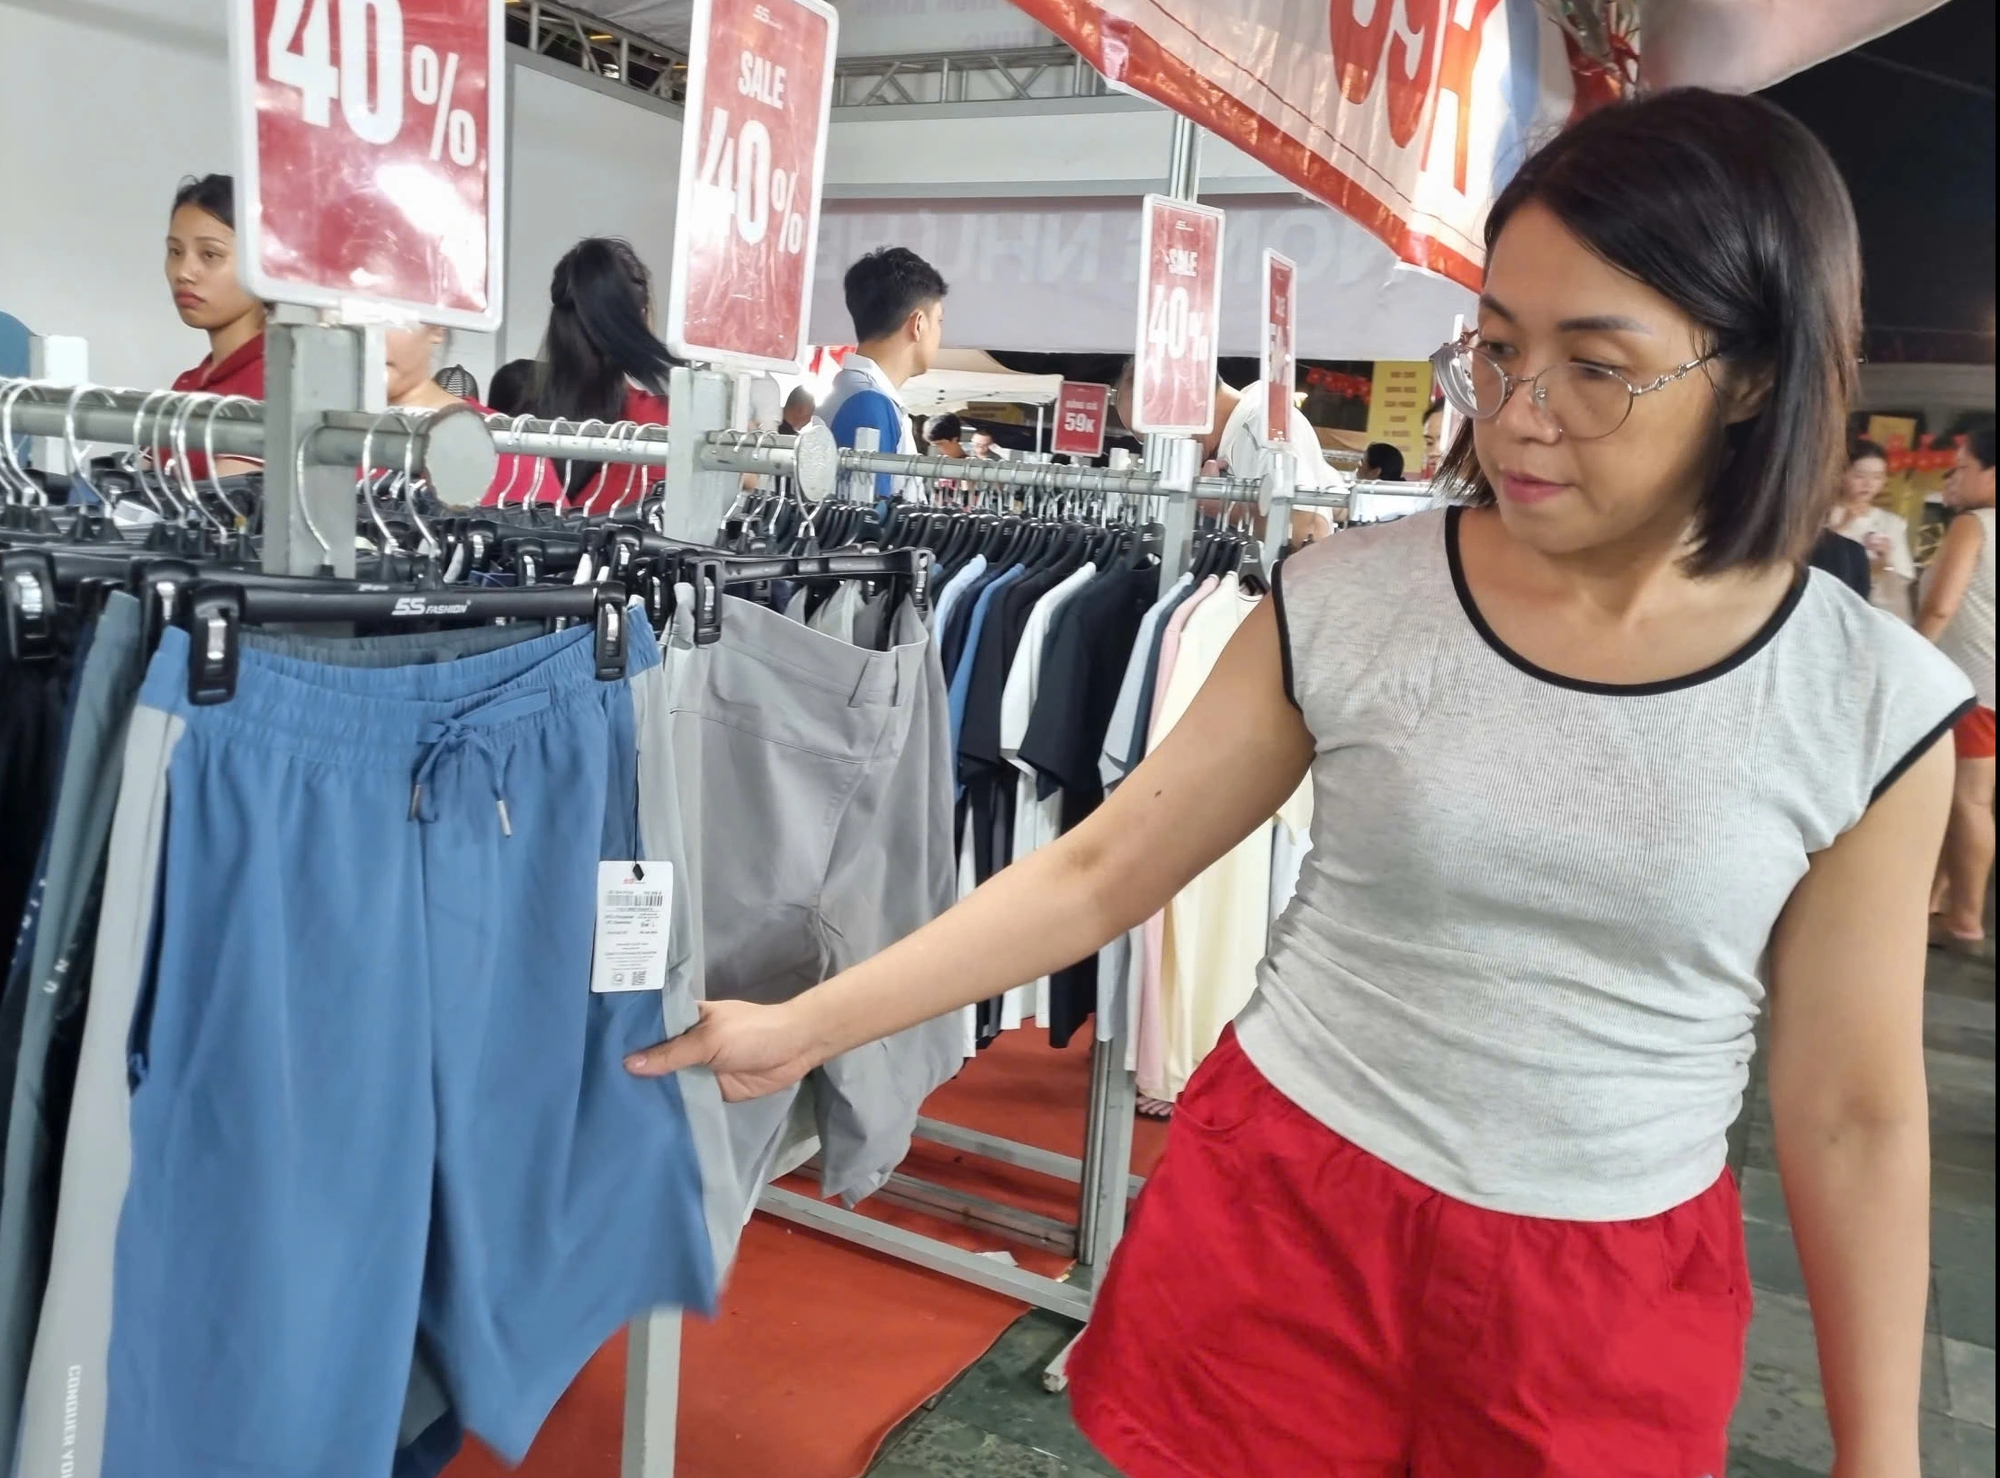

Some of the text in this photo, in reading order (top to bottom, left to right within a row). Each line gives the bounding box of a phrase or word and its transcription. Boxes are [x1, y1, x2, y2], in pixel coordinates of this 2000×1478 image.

[267, 0, 477, 167] 40%
[737, 49, 787, 111] SALE
[697, 107, 803, 255] 40%
[1167, 248, 1199, 278] SALE
[1148, 284, 1209, 362] 40%
[426, 604, 468, 614] FASHION
[63, 1364, 81, 1446] CONQUER
